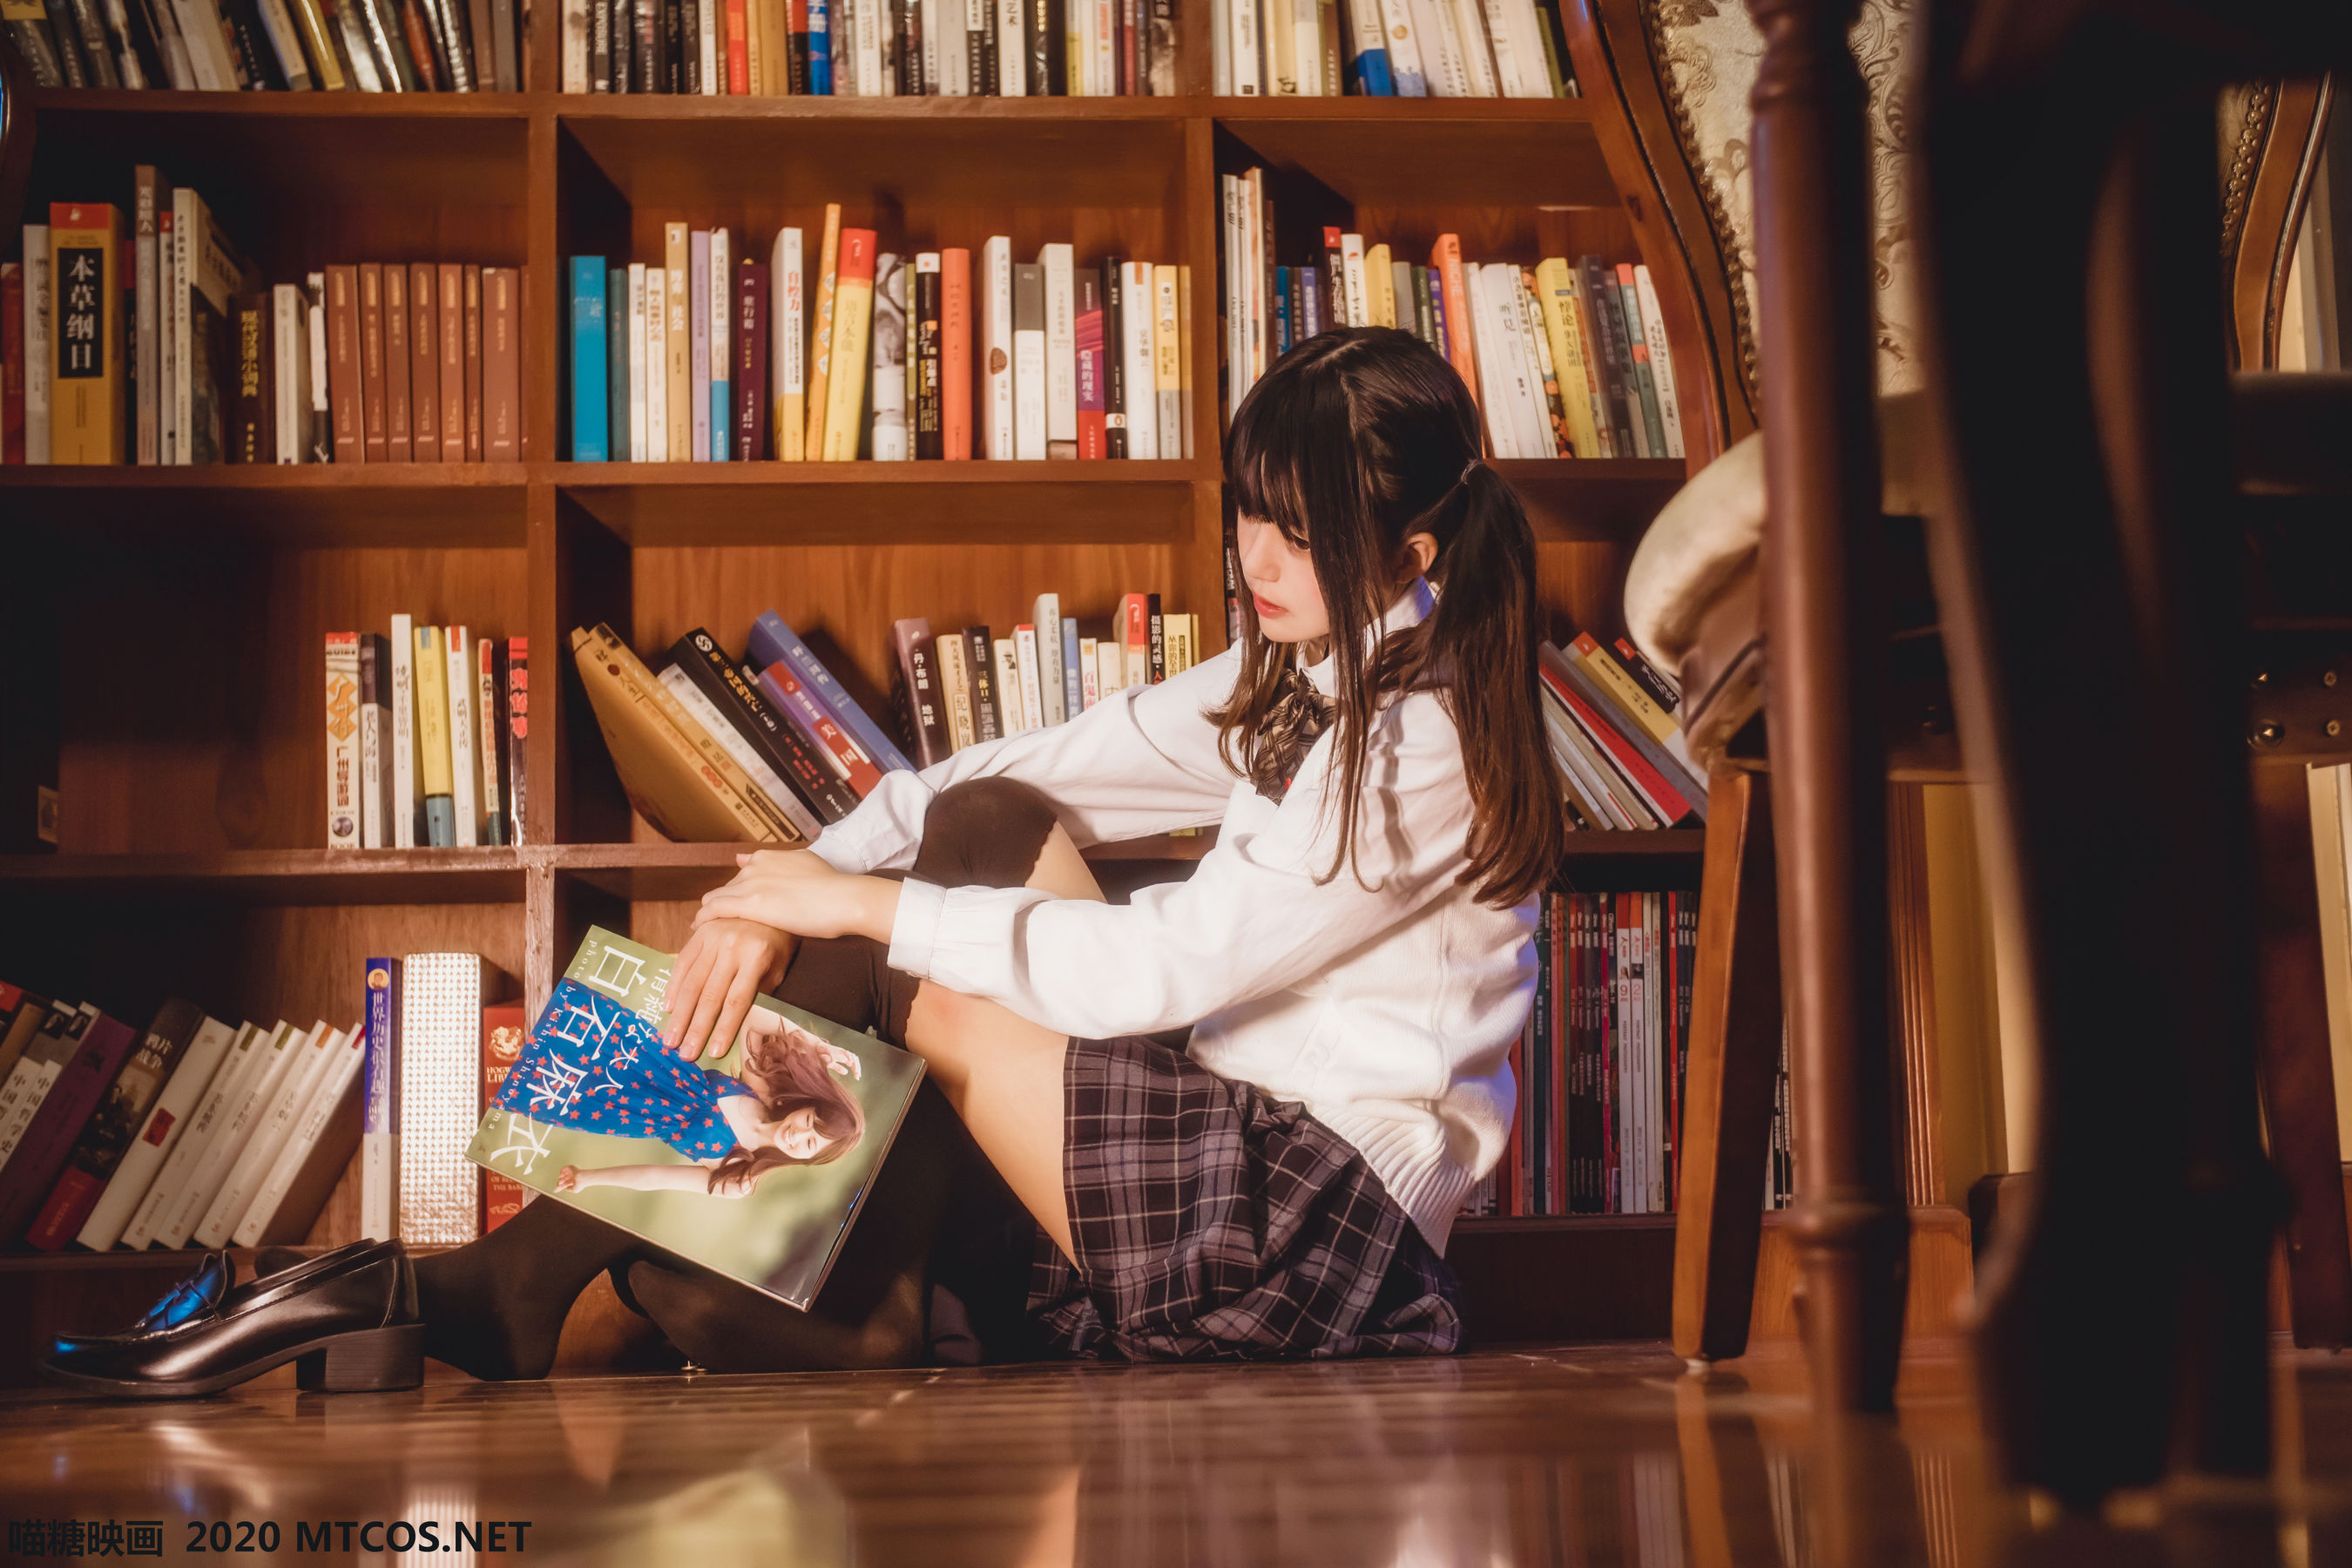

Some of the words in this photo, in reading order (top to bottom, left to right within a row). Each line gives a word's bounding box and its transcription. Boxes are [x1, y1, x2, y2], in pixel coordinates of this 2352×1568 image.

[65, 253, 96, 370] 本草纲目
[531, 1007, 564, 1051] Kishin
[559, 984, 578, 1003] by
[487, 1057, 535, 1132] Shinoyama
[490, 944, 646, 1175] 白石麻衣
